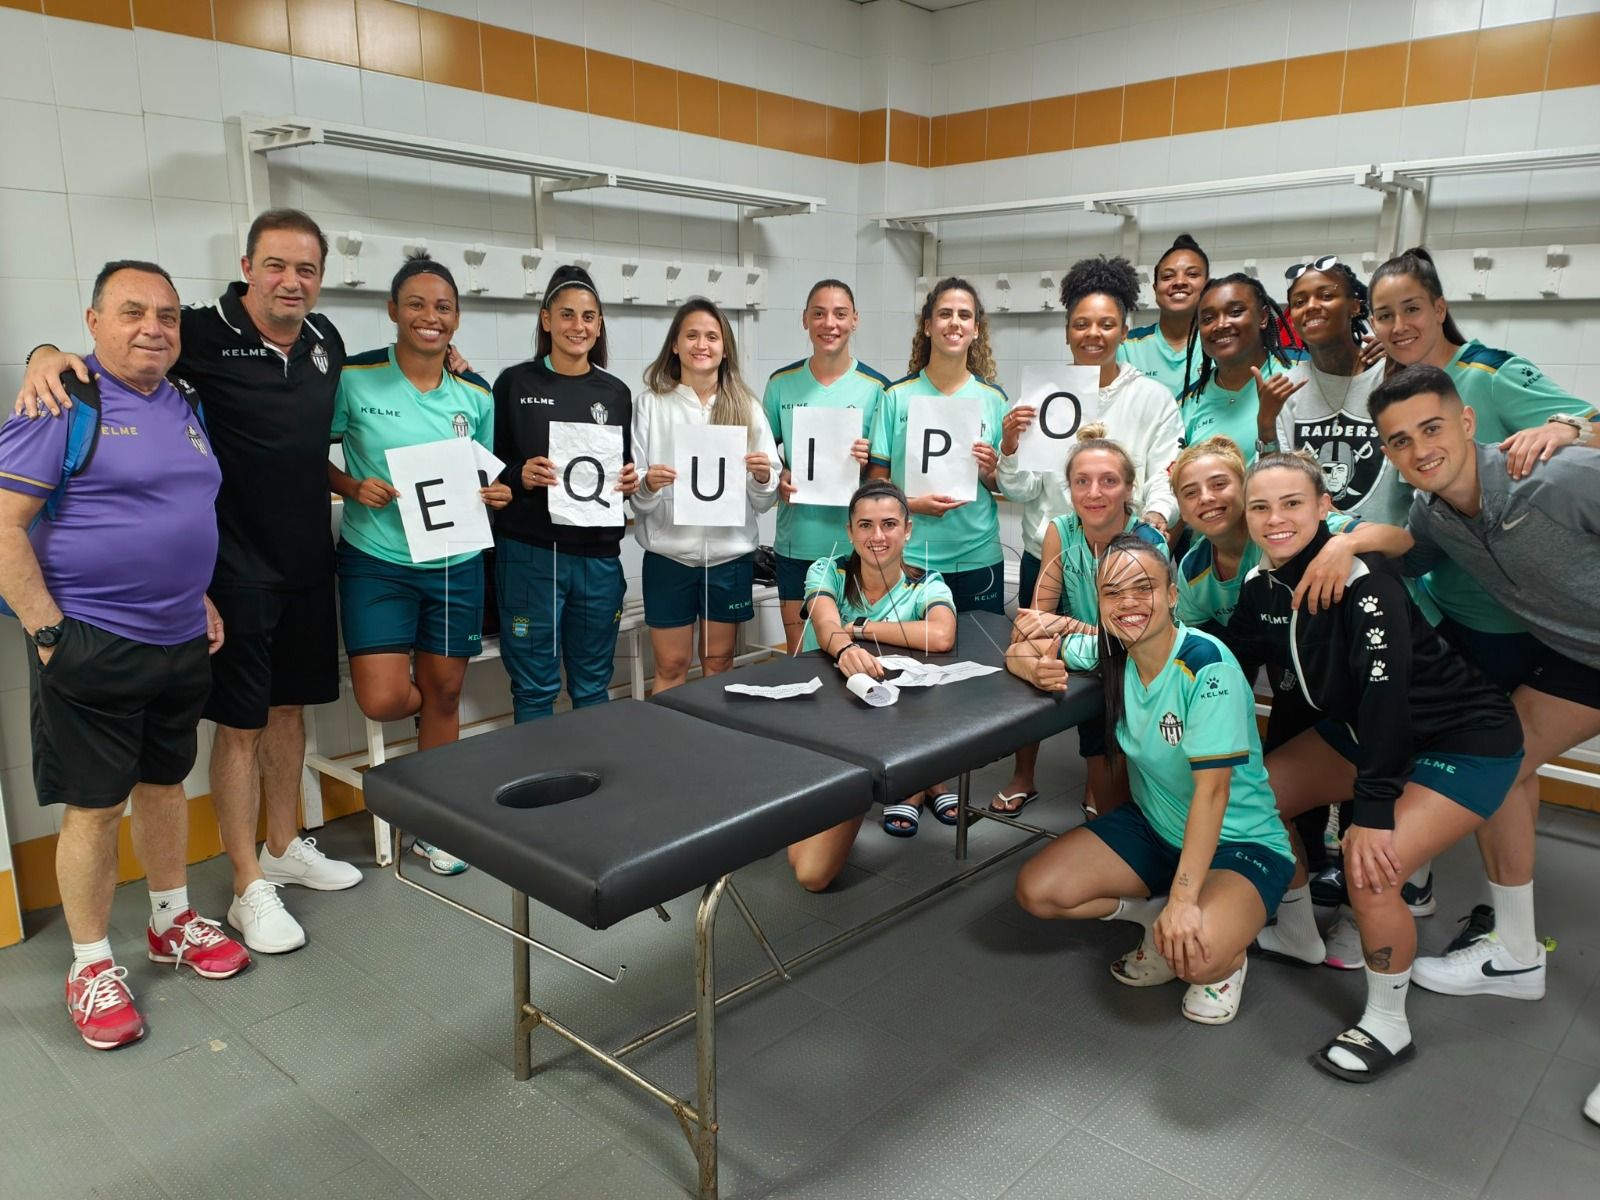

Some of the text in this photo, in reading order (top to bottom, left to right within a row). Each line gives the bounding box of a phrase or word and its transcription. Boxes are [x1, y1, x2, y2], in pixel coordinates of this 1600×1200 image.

[221, 348, 269, 357] KELME
[520, 397, 555, 405] KELME
[360, 406, 401, 417] KELME
[1038, 391, 1083, 440] O
[101, 426, 139, 436] ELME
[1300, 425, 1379, 437] RAIDERS
[806, 437, 816, 482] I
[921, 428, 953, 475] P
[563, 455, 611, 508] Q
[690, 455, 726, 502] U
[414, 477, 456, 532] E
[1260, 613, 1289, 624] KLME
[1200, 689, 1231, 700] KELME
[1415, 758, 1457, 774] ELME
[1235, 851, 1270, 874] ELME
